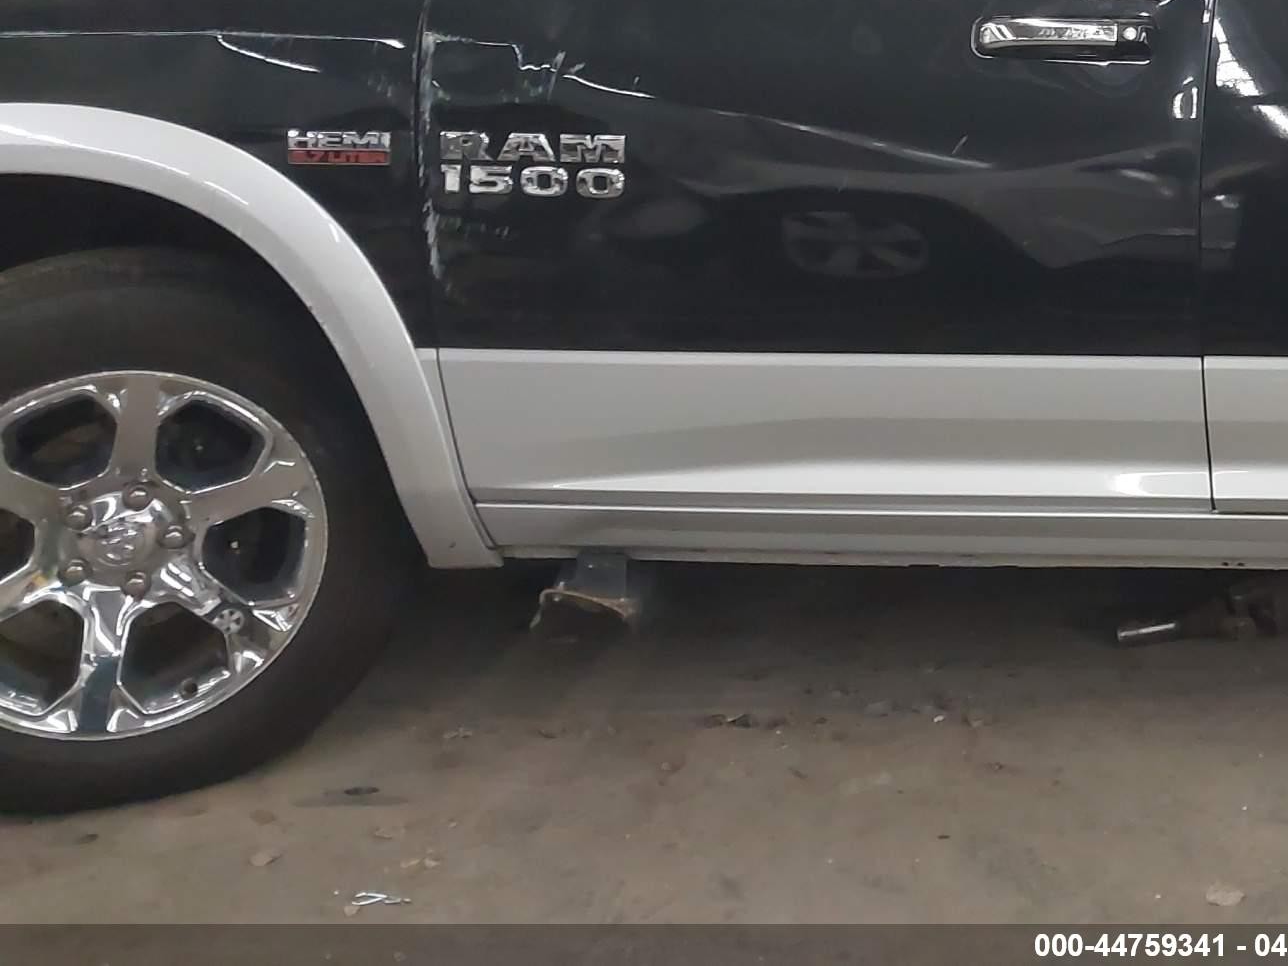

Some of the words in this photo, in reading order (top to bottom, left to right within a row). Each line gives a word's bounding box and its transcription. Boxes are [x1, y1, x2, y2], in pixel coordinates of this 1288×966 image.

[287, 129, 391, 150] HEMI
[440, 131, 626, 164] RAM
[440, 164, 626, 198] 1500
